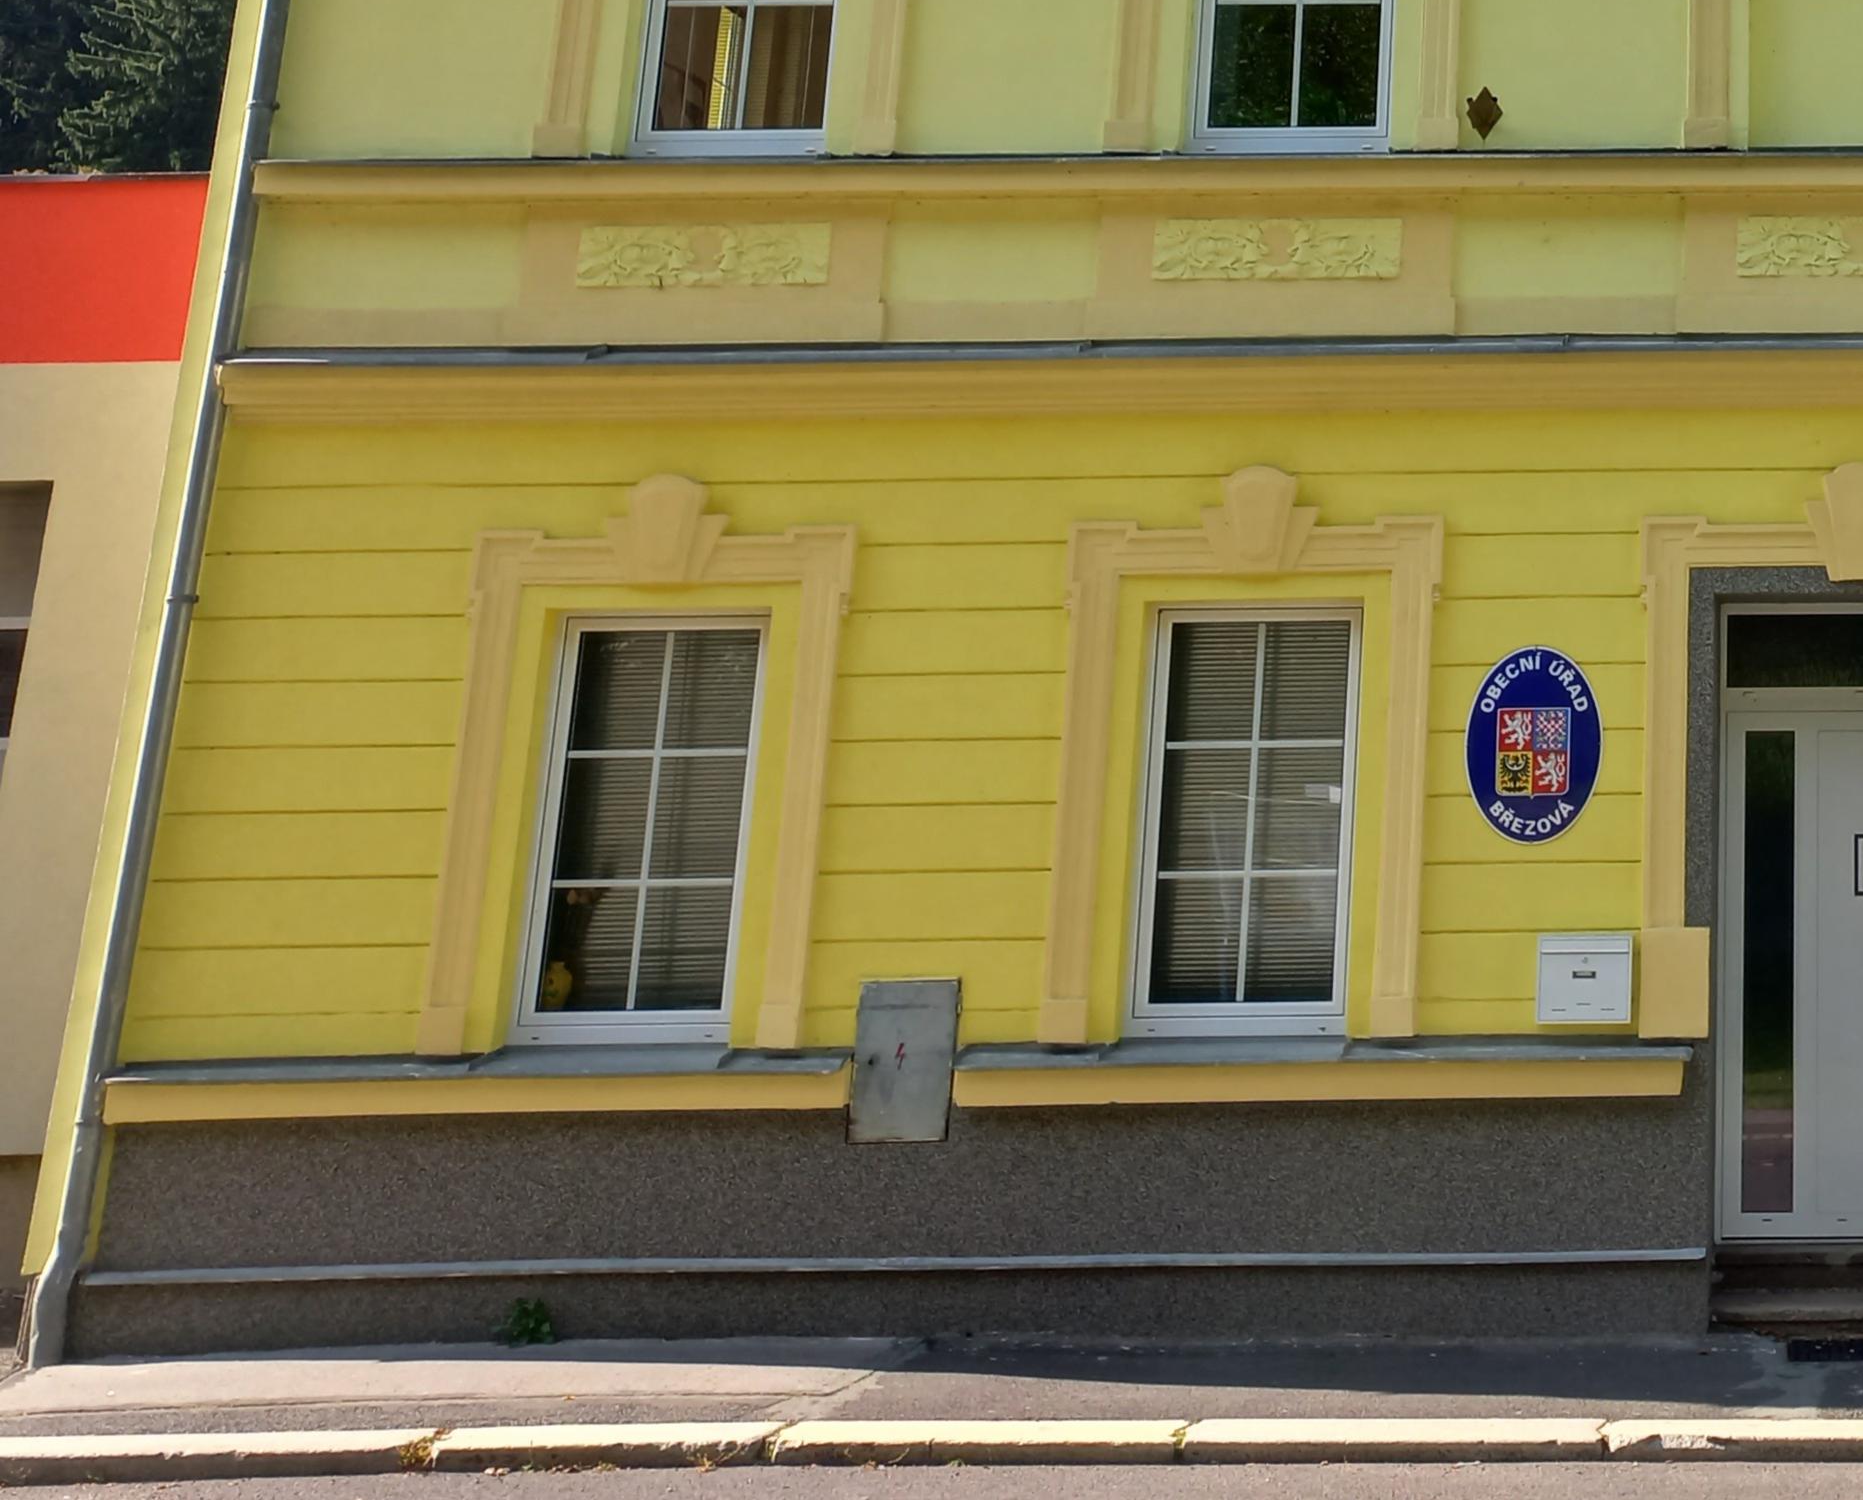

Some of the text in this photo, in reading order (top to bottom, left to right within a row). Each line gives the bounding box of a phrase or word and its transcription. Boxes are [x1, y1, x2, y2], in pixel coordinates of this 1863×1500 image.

[1480, 652, 1588, 713] OBECNÍ ÚŘAD
[1489, 800, 1574, 835] BŘEZOVÁ
